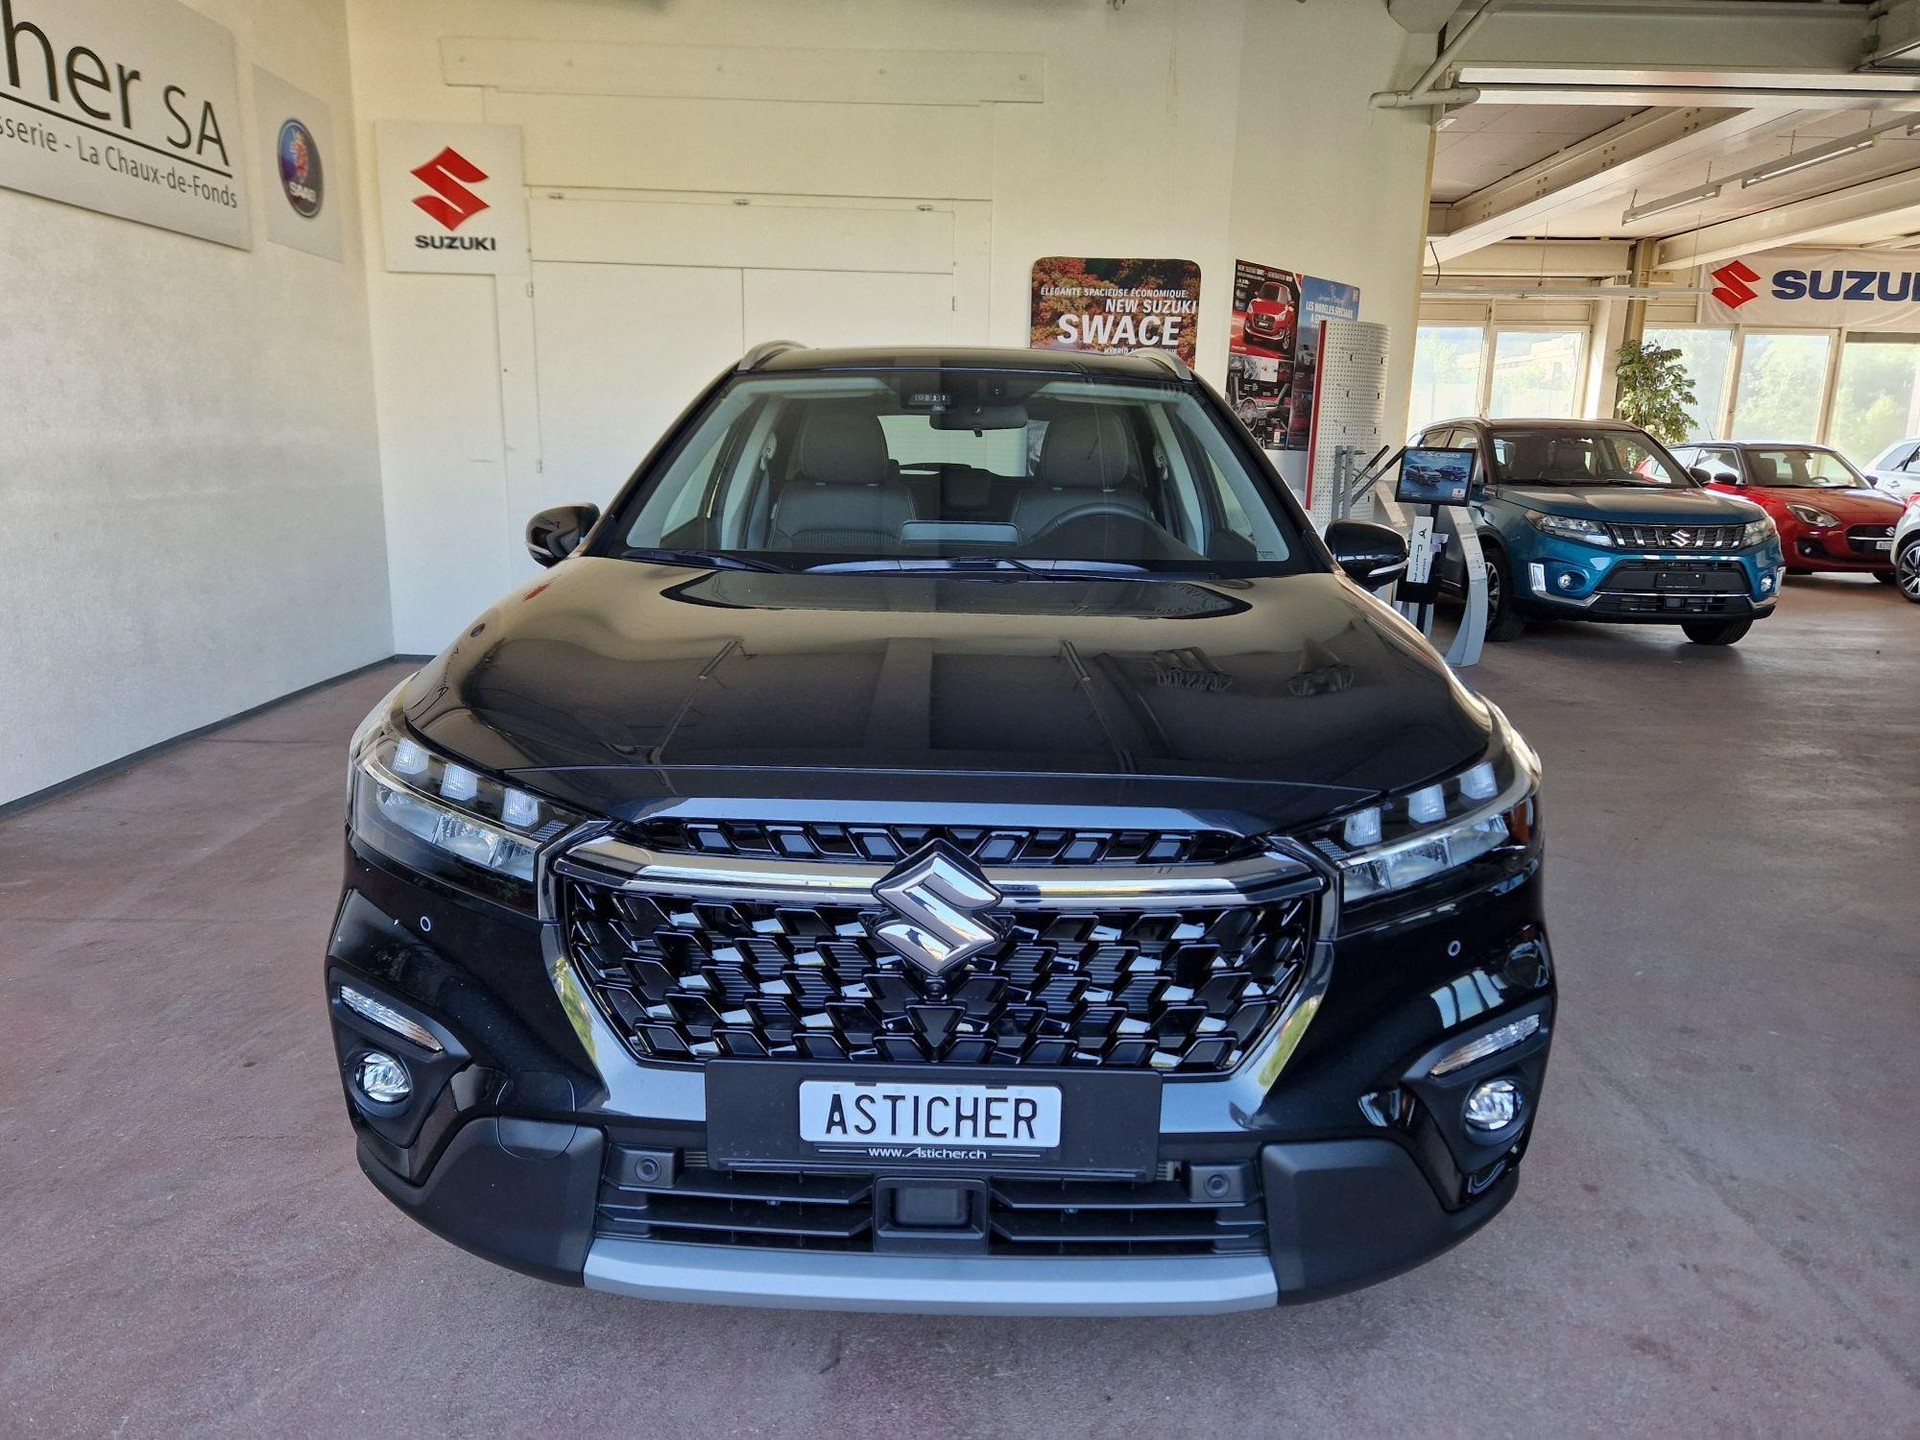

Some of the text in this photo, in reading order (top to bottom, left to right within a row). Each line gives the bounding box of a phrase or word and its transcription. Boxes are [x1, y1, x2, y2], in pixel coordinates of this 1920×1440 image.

[163, 84, 230, 167] SA
[0, 116, 58, 153] serie
[77, 136, 100, 165] La
[105, 146, 238, 209] Chaux-de-Fonds
[415, 235, 496, 251] SUZUKI
[1084, 288, 1129, 297] SPACIEUSE
[1106, 299, 1197, 314] NEW SUZUKI
[1056, 314, 1182, 346] SWACE
[825, 1093, 1038, 1139] ASTICHER
[868, 1147, 987, 1160] www.Asticher.ch
